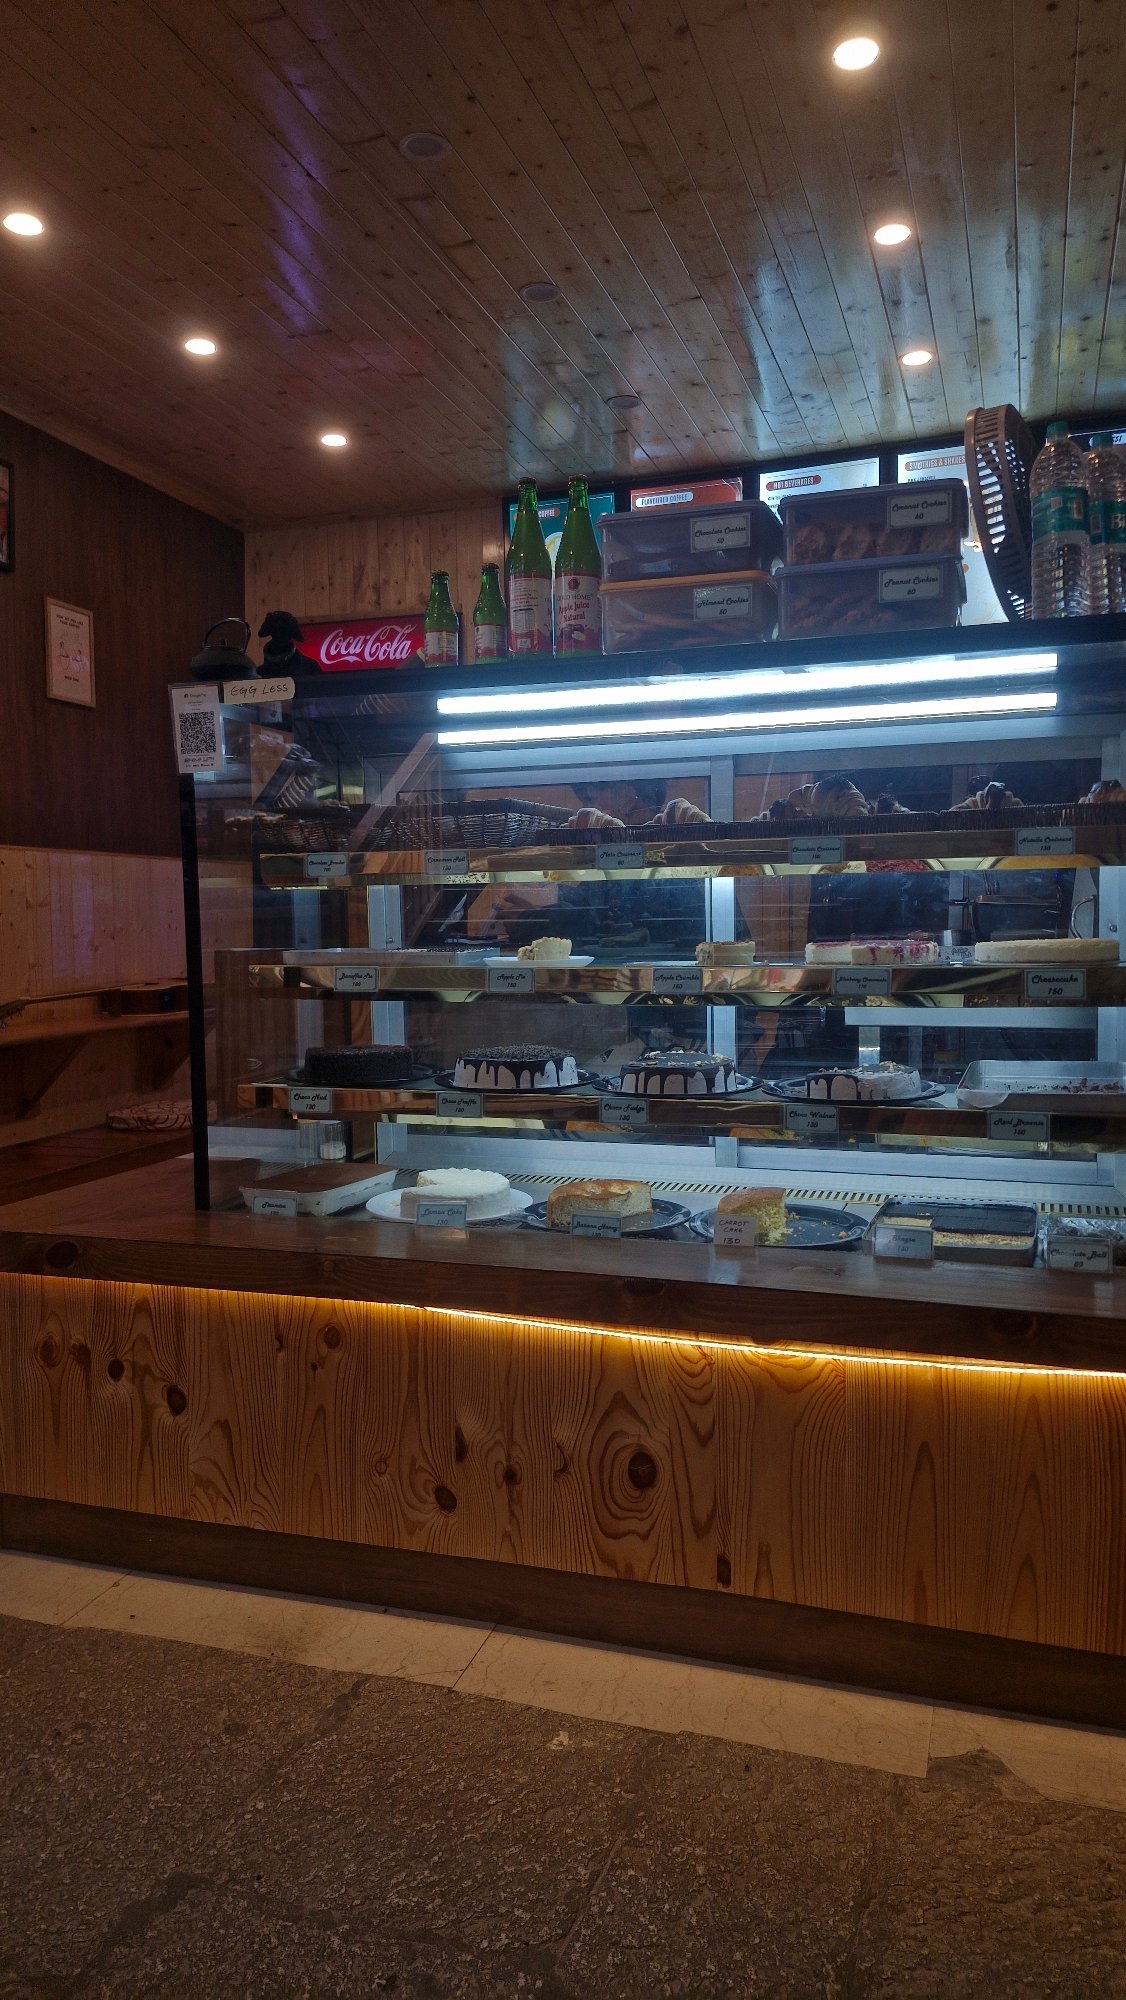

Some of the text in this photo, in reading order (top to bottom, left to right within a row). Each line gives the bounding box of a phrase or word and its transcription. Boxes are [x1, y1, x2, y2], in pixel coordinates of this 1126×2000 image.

[938, 458, 943, 466] &
[944, 456, 966, 466] SHAKES
[773, 477, 814, 490] HOT BEVERAGES
[641, 494, 688, 506] FLAVOURED COFFEE
[892, 499, 947, 512] Coconut Cookies
[538, 508, 556, 518] COFFEE
[695, 526, 746, 537] Chocolate Cookies
[884, 575, 938, 588] Peanut Cookies
[574, 593, 592, 601] HOME
[696, 597, 749, 608] Almond Cookies
[558, 601, 590, 615] Apple Juice
[563, 611, 587, 622] Natural
[320, 624, 417, 664] Coca-Cola
[231, 683, 288, 698] EGG LESS
[655, 974, 675, 983] Apple
[1031, 974, 1078, 984] Cheesecake
[293, 1093, 328, 1101] Choco Mud
[457, 1098, 477, 1107] Truffle
[603, 1103, 645, 1113] Choco Fudge
[789, 1110, 836, 1119] Choco Walnut
[1013, 1118, 1044, 1128] Brownie
[420, 1208, 463, 1217] Lemon Cake
[718, 1219, 750, 1227] CARROT
[723, 1237, 741, 1245] 130
[1050, 1248, 1107, 1261] Cholate Ball
